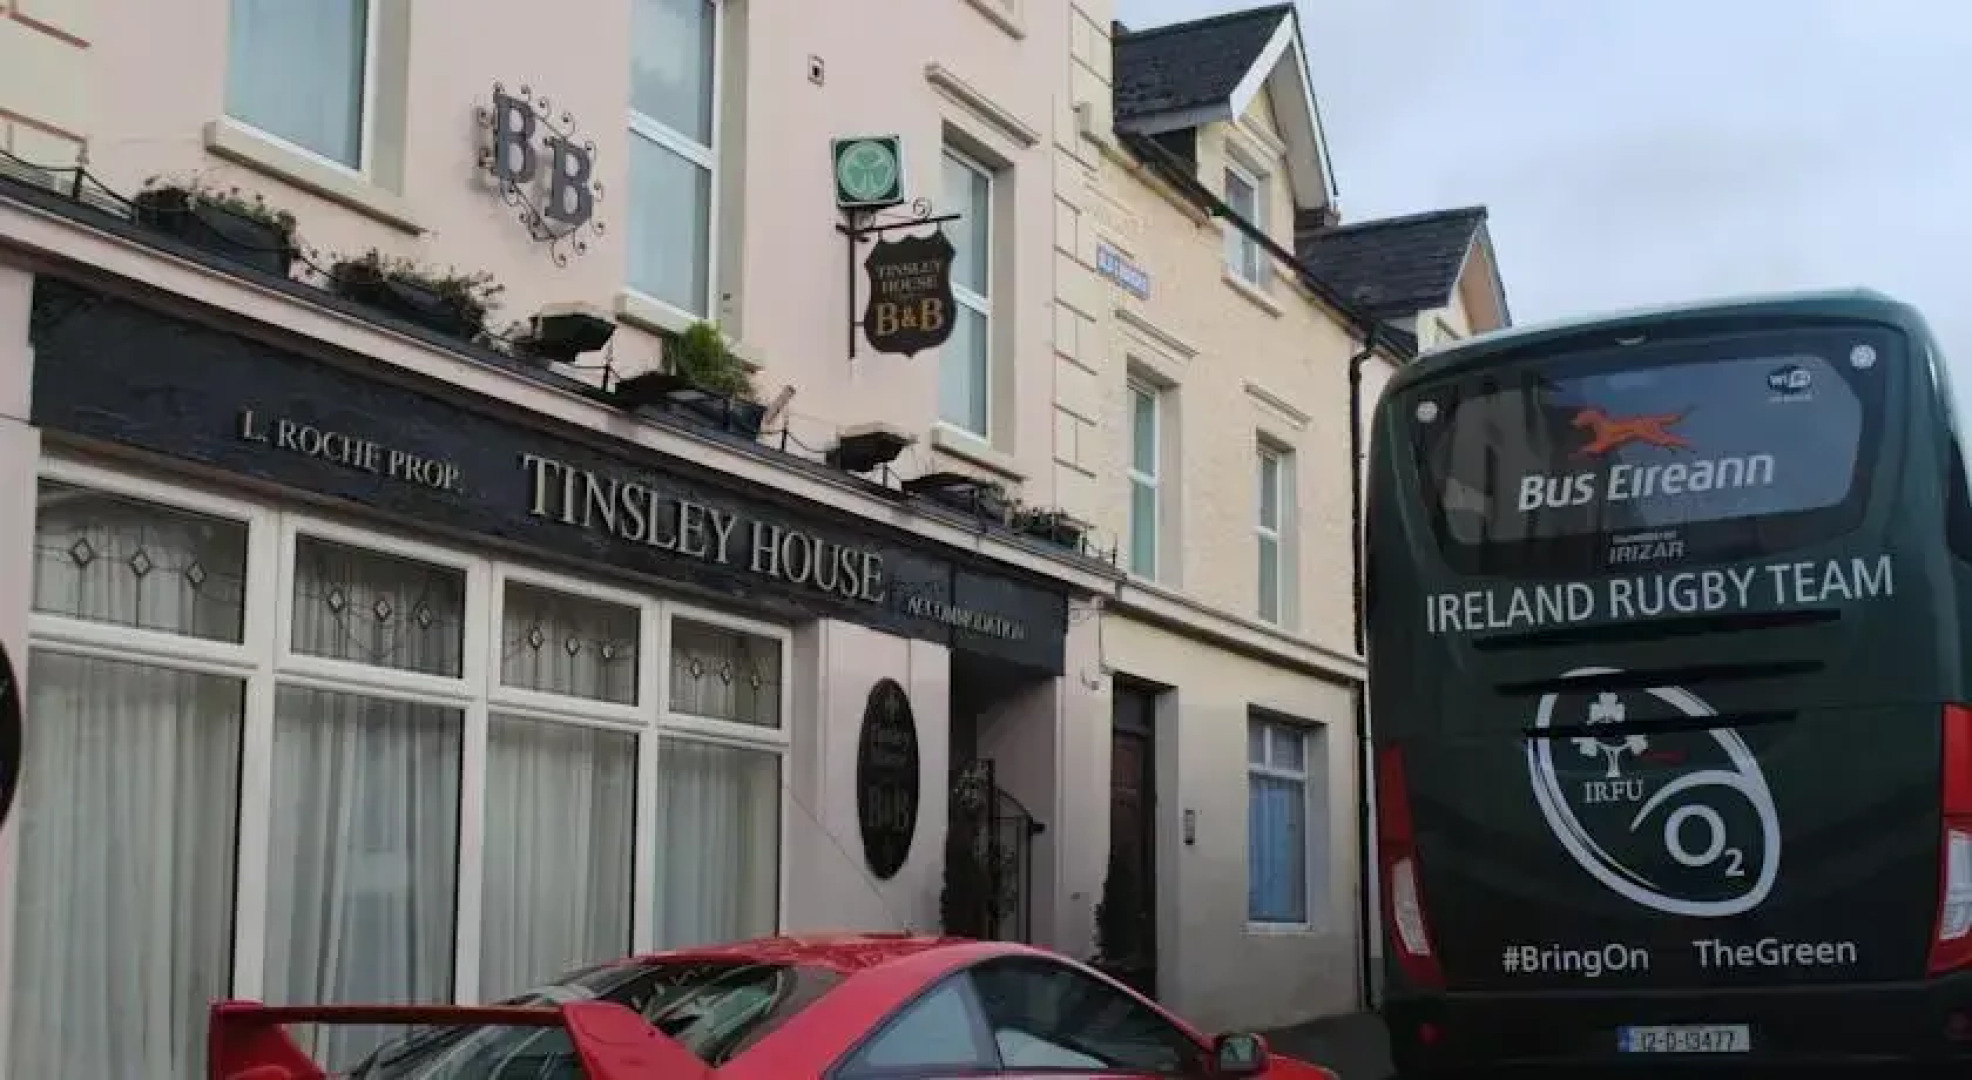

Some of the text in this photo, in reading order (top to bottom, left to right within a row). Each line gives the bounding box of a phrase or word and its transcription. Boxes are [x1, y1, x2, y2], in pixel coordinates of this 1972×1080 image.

[874, 298, 944, 337] B&B
[278, 418, 379, 474] ROCHE
[1518, 474, 1595, 513] Bus
[523, 453, 884, 602] TINSLEY HOUSE
[1609, 540, 1684, 564] IRIZAR
[1426, 555, 1892, 633] IRELAND RUGBY TEAM
[1584, 779, 1644, 803] IRFU
[1502, 938, 1858, 977] #BringOn TheGreen
